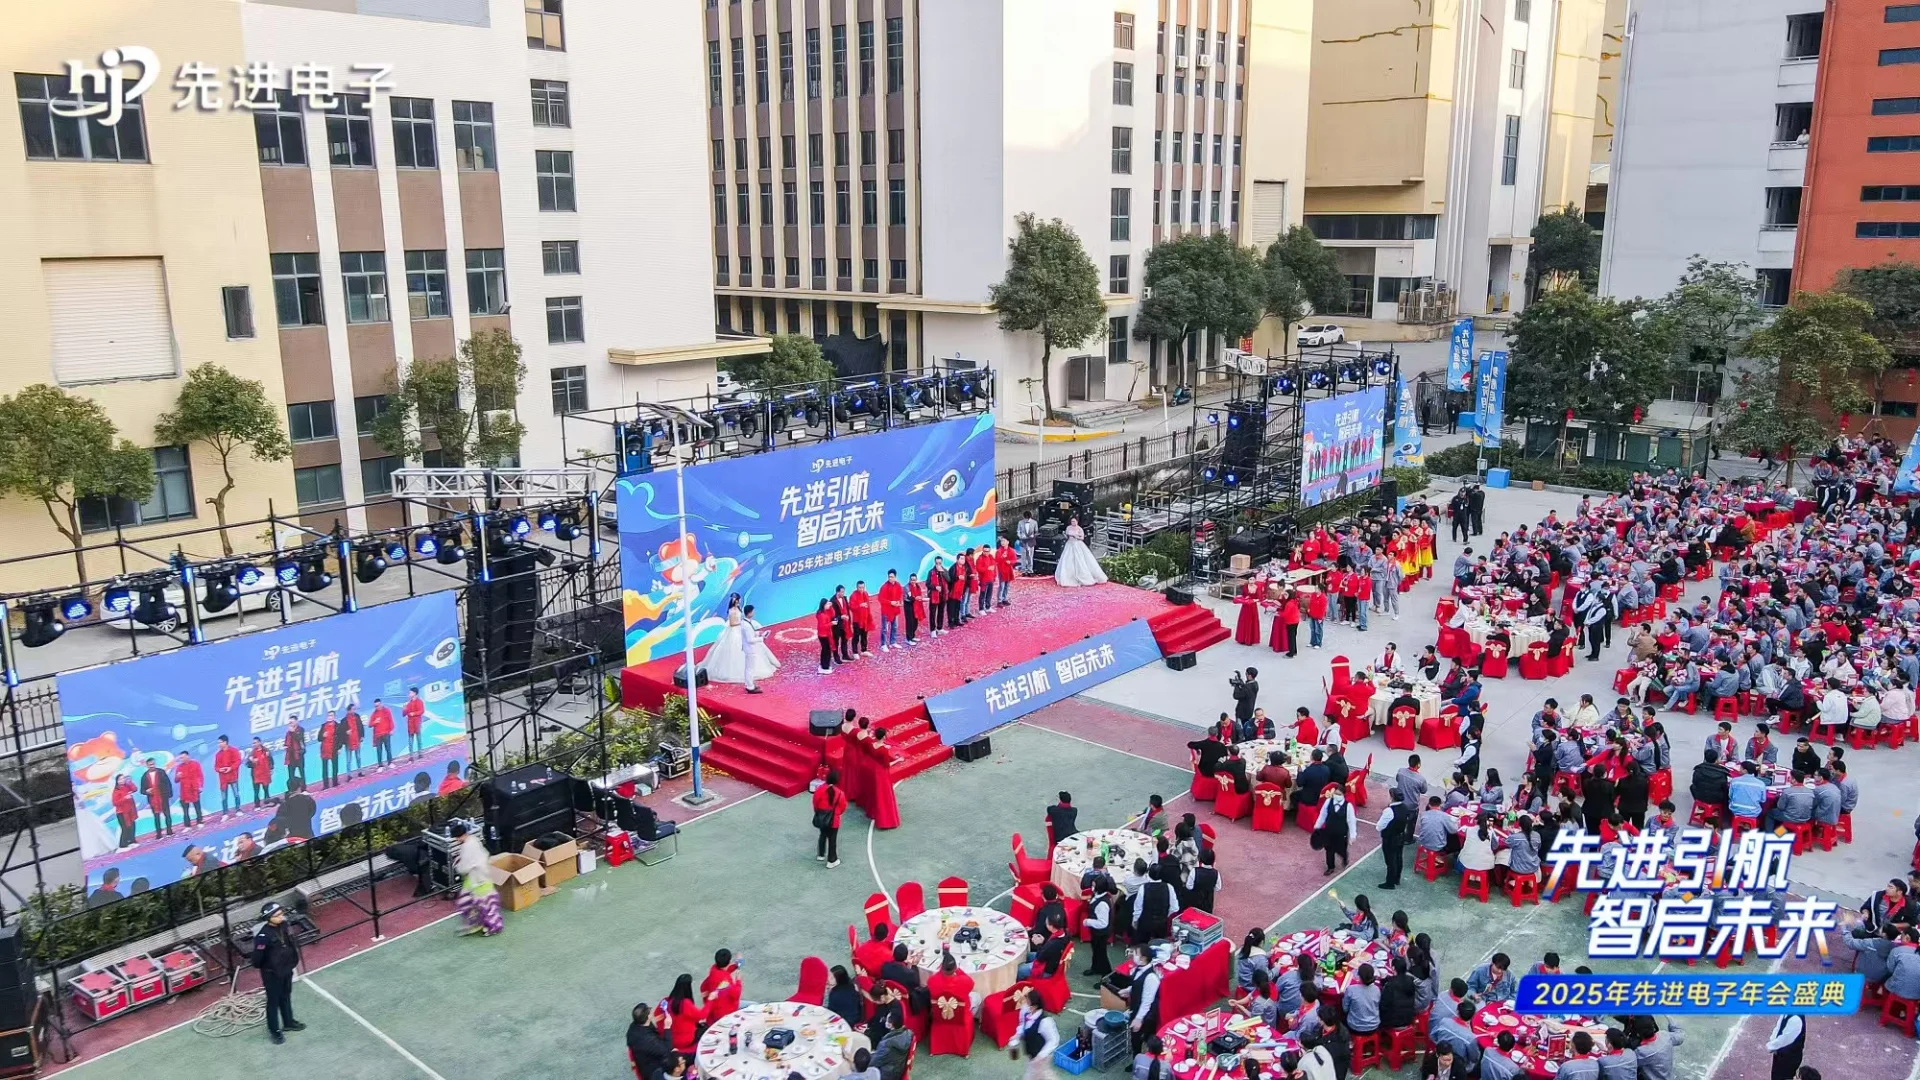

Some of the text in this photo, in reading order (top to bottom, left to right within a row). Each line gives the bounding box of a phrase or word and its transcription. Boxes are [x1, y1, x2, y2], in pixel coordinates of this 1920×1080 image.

[780, 470, 870, 522] 先进引航
[797, 500, 885, 548] 智启未来
[778, 538, 889, 577] 2025年先进电子年会盛典
[224, 651, 340, 711] 先进引航
[985, 643, 1116, 715] 先进引航 智启未来
[249, 679, 361, 734] 智启未来
